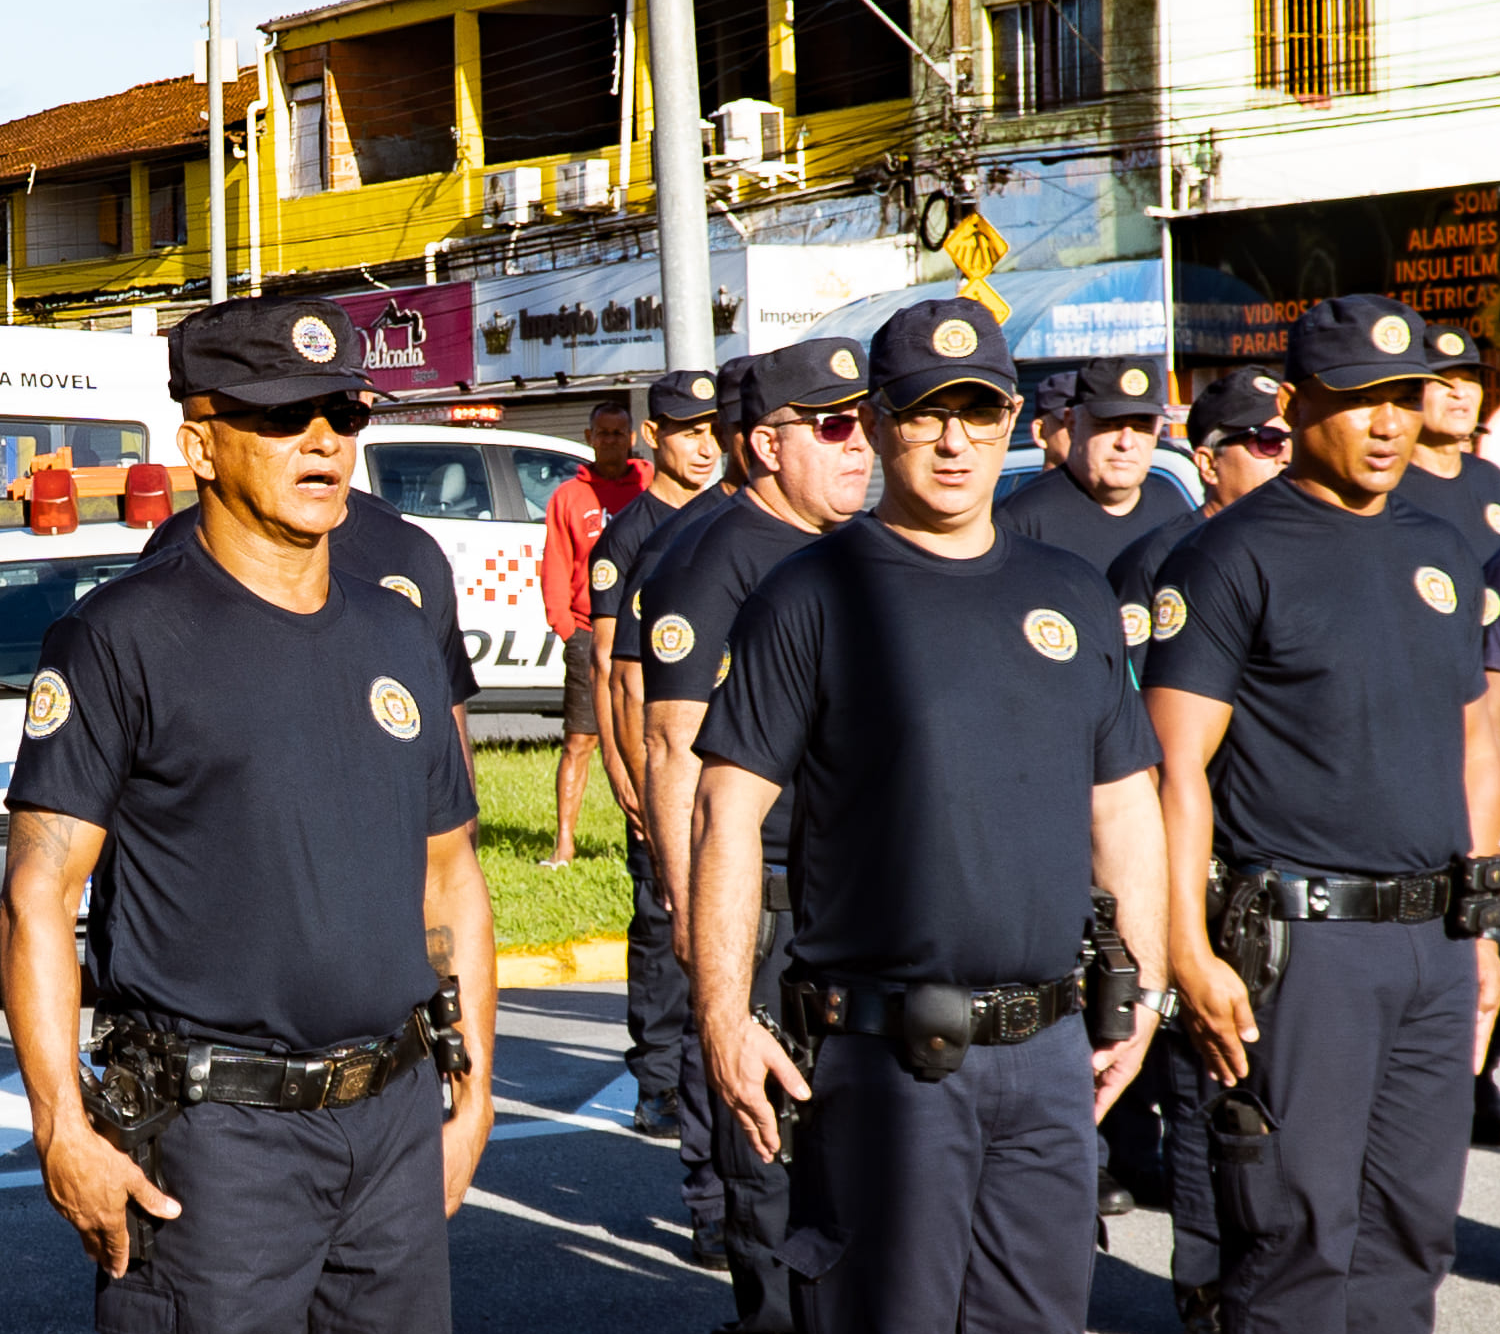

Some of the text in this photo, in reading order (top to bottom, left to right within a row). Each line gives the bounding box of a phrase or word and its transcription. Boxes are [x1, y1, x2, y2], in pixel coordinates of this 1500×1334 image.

[1453, 190, 1499, 216] SOM
[1408, 222, 1498, 252] ALARMES
[1395, 254, 1498, 283] INSULFILM
[1401, 280, 1499, 313] ELÉTRICAS
[20, 372, 99, 390] MOVEL
